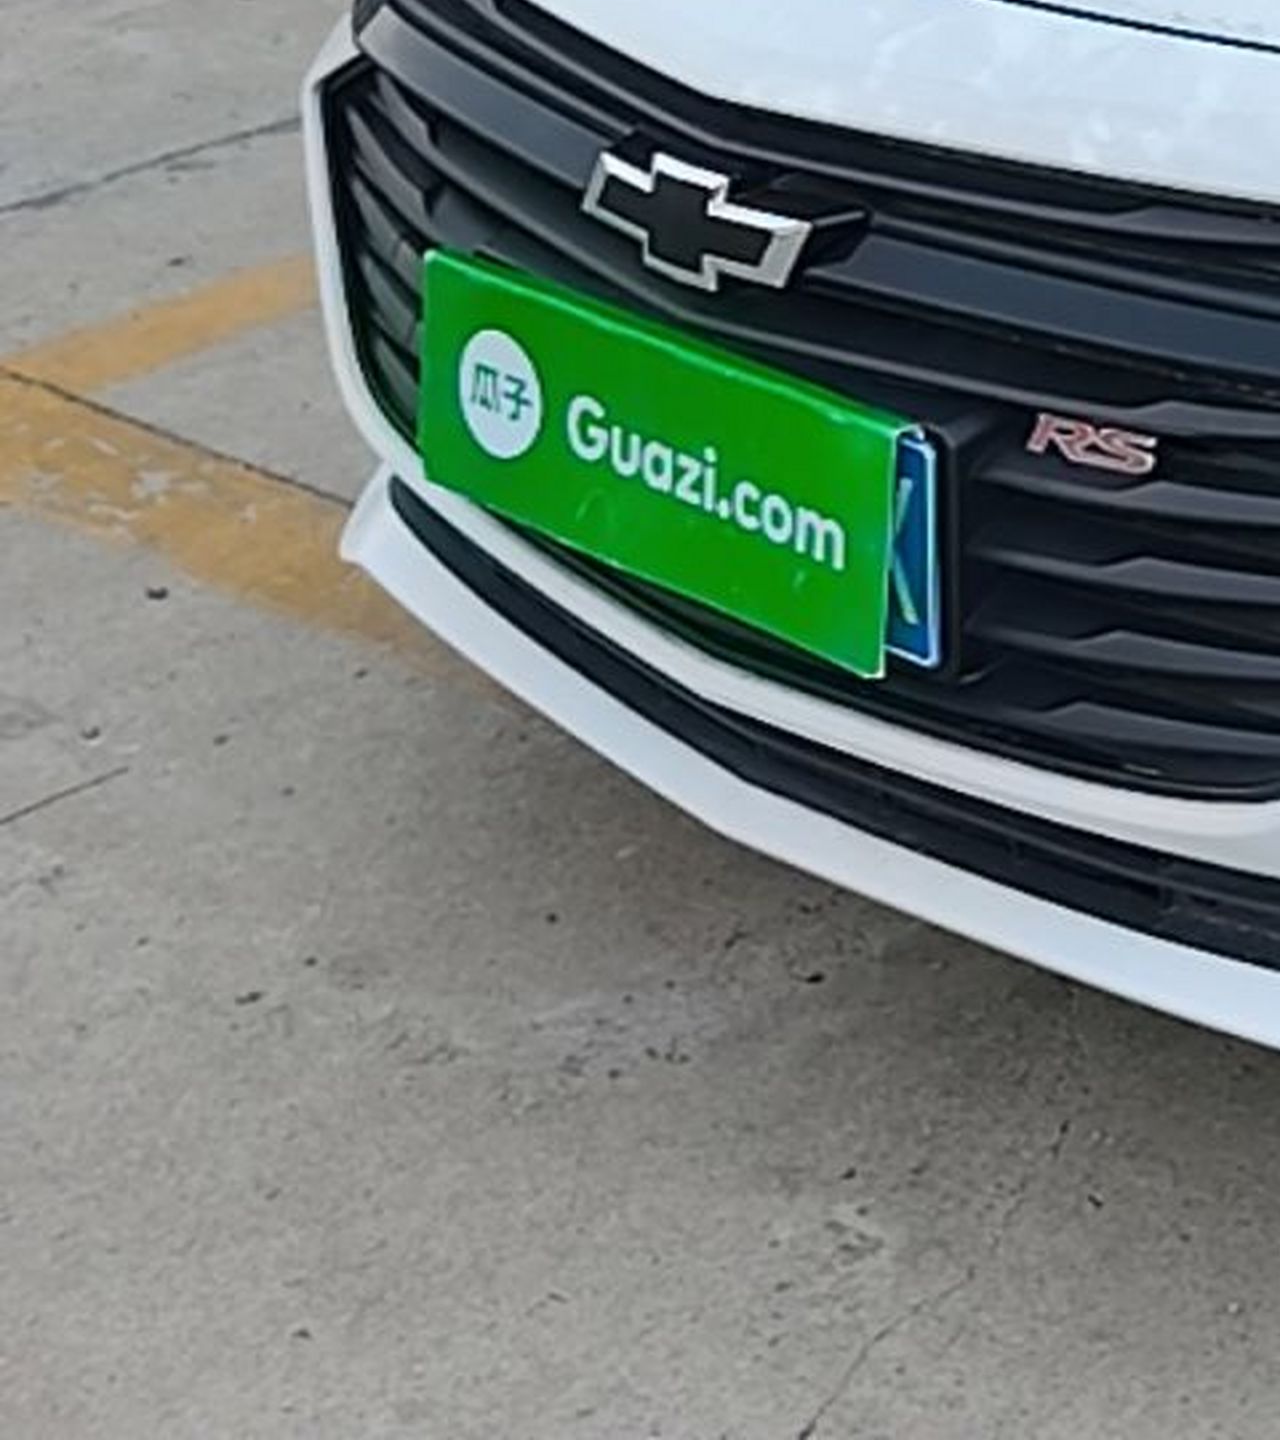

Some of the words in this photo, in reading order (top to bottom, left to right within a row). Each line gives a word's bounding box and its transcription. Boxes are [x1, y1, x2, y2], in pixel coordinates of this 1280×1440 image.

[469, 362, 533, 421] 瓜子
[1026, 412, 1158, 475] RS
[566, 394, 847, 572] Guazi.com
